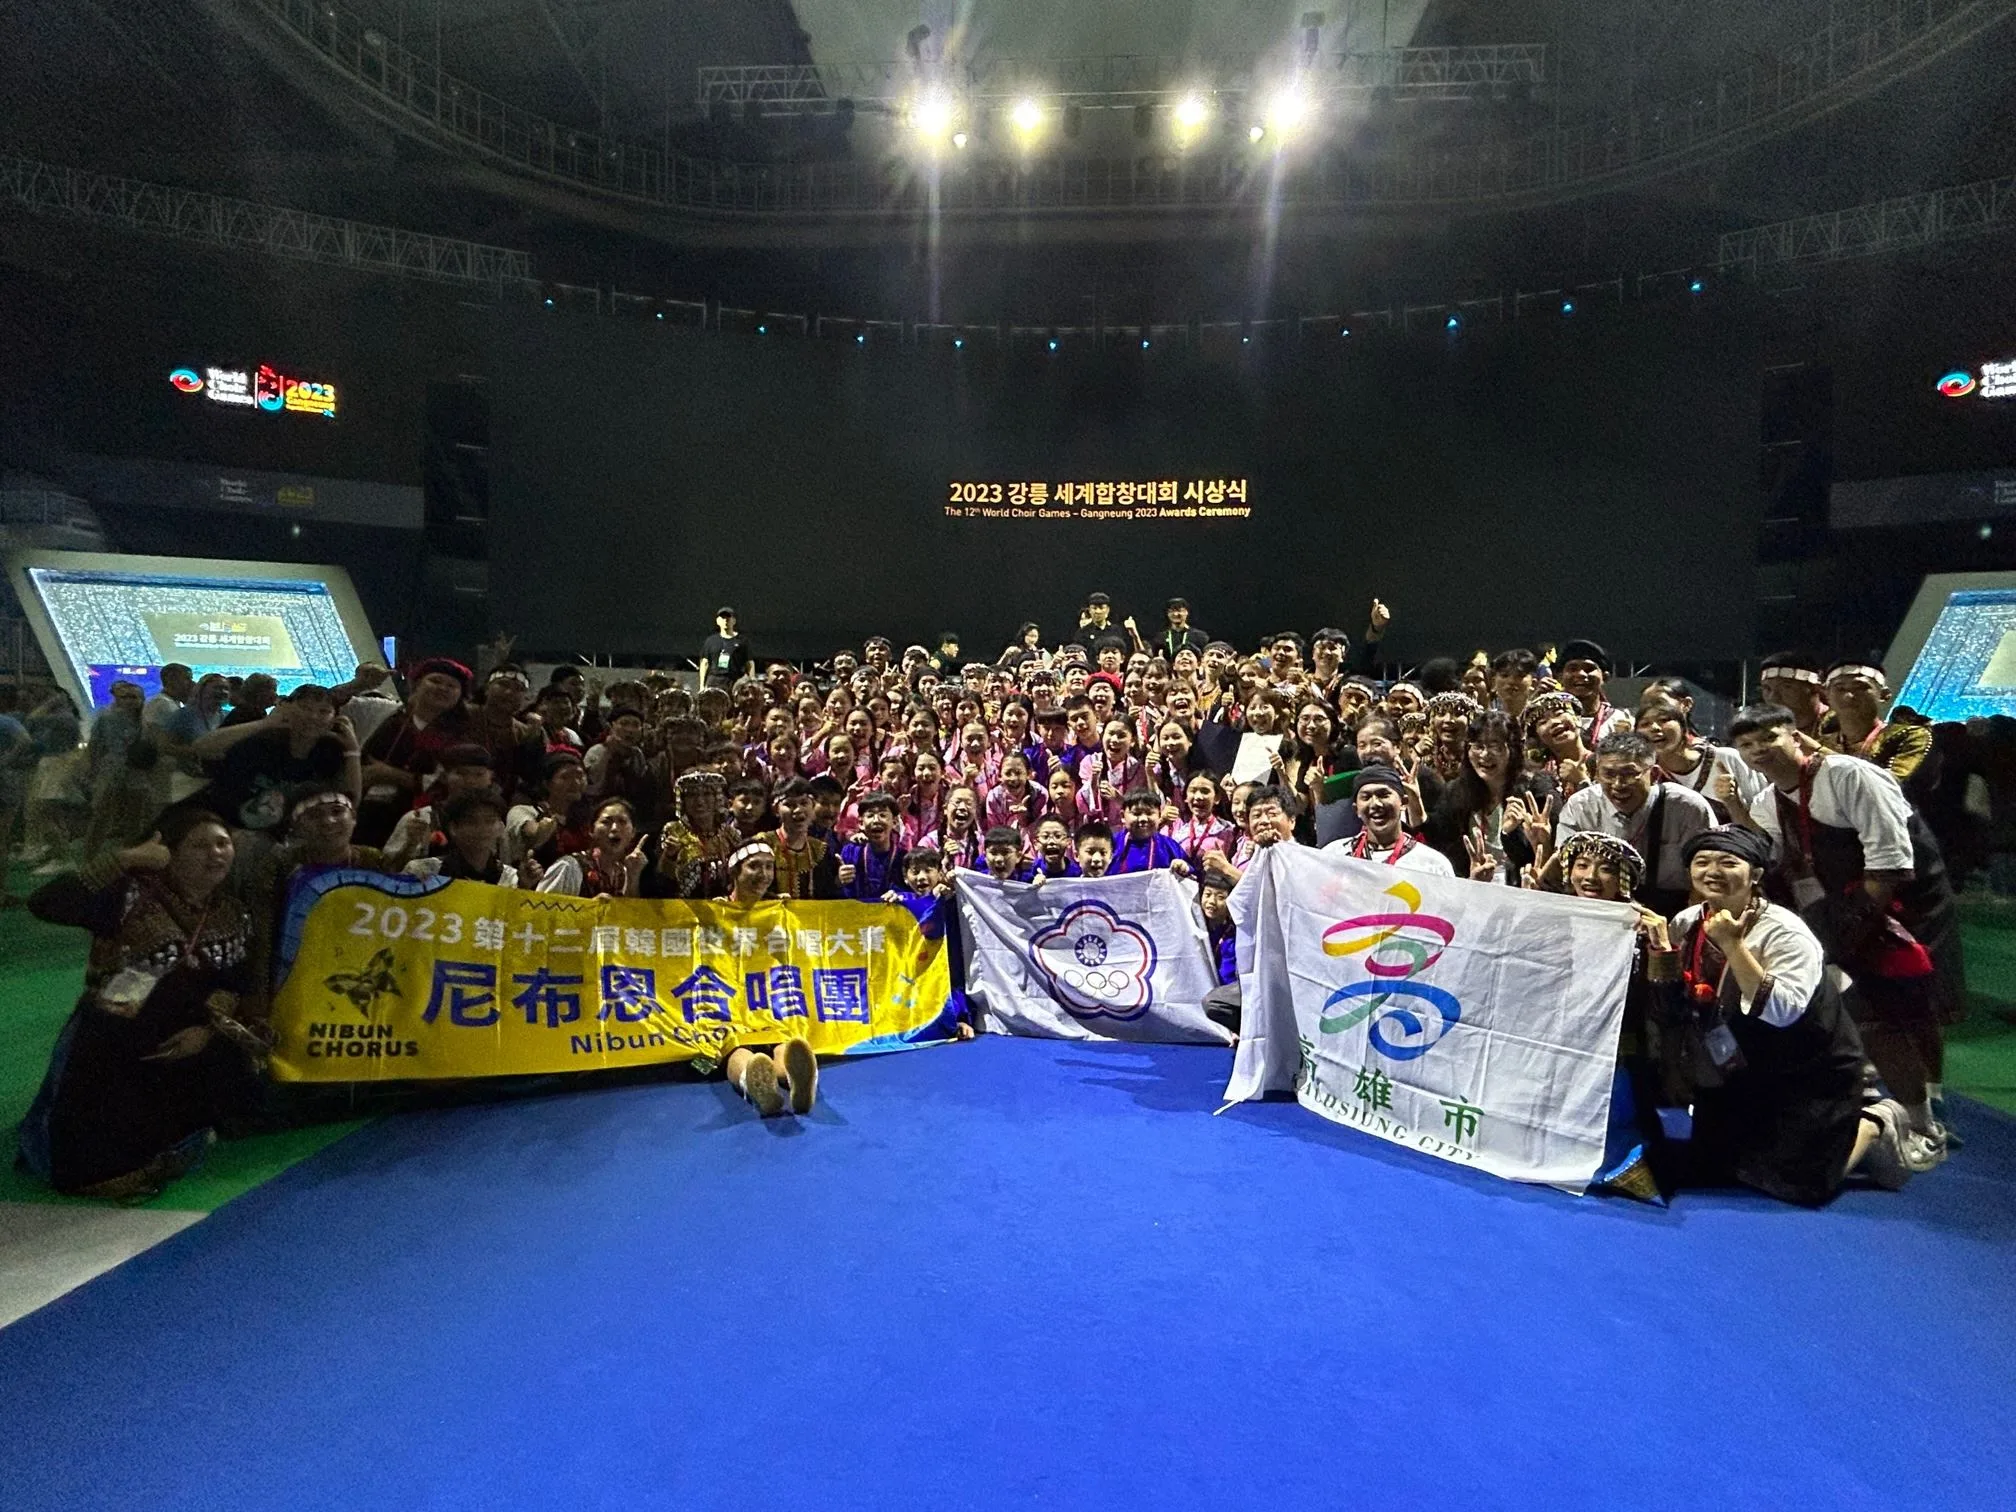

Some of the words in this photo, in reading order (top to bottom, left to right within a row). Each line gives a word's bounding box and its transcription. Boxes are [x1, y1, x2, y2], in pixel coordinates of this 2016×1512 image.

[285, 380, 335, 402] 2023
[949, 482, 1003, 503] 2023
[1008, 482, 1049, 505] 강릉
[1054, 480, 1178, 505] 세계합창대회
[1183, 479, 1247, 504] 시상식
[944, 506, 962, 516] The
[965, 507, 981, 517] 12th
[982, 507, 1010, 518] World
[1011, 508, 1037, 518] Choir
[1038, 508, 1071, 518] Games
[1080, 508, 1133, 520] Gangneung
[1135, 508, 1158, 518] 2023
[1159, 507, 1197, 518] Awards
[1198, 506, 1251, 519] Ceremony
[349, 902, 464, 945] 2023
[421, 959, 871, 1028] 尼布恩合唱團
[308, 1022, 394, 1039] NIBUN
[307, 1040, 419, 1058] CHORUS
[570, 1030, 666, 1055] Nibun
